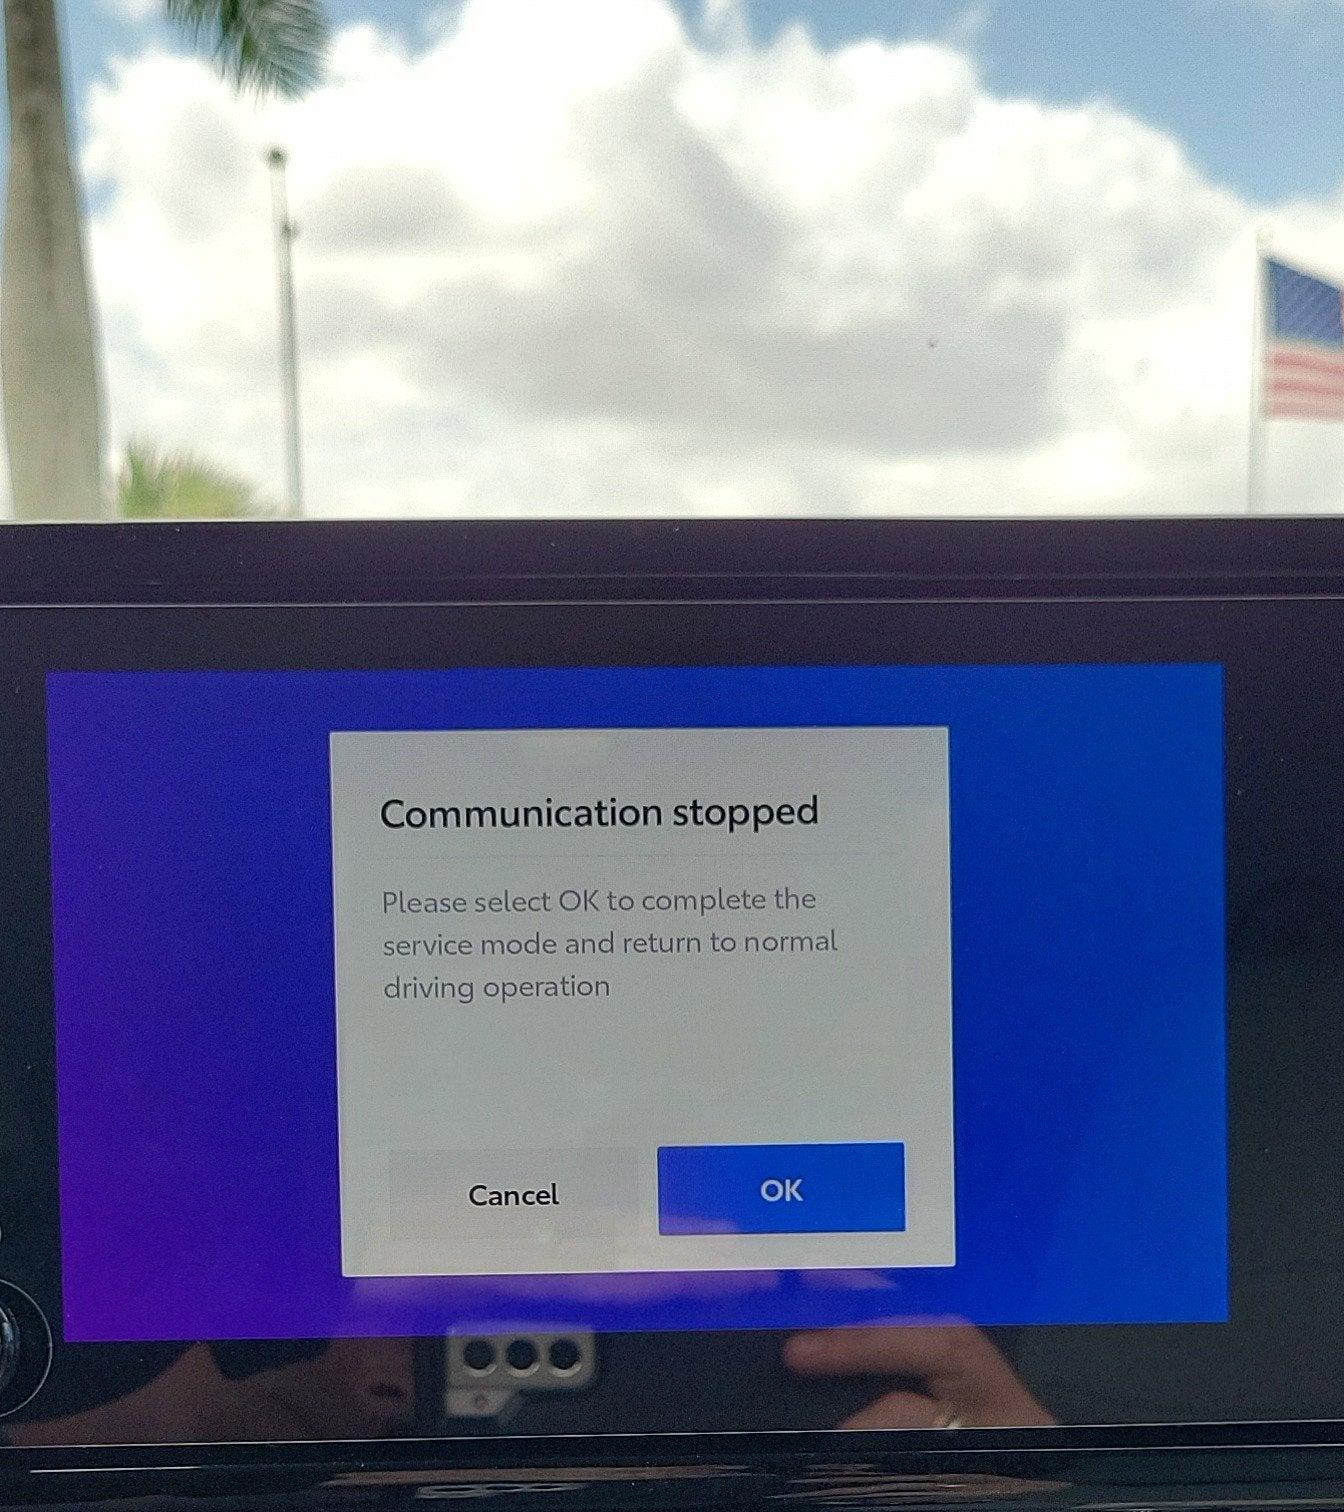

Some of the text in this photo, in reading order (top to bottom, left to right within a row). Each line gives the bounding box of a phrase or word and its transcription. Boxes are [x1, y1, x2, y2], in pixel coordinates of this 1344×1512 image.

[379, 795, 819, 833] Communication stopped
[382, 886, 817, 917] Please select OK to complete the
[383, 929, 839, 957] service mode and return to normal
[384, 974, 610, 1003] driving operation
[468, 1182, 560, 1207] Cancel
[760, 1179, 803, 1203] OK
